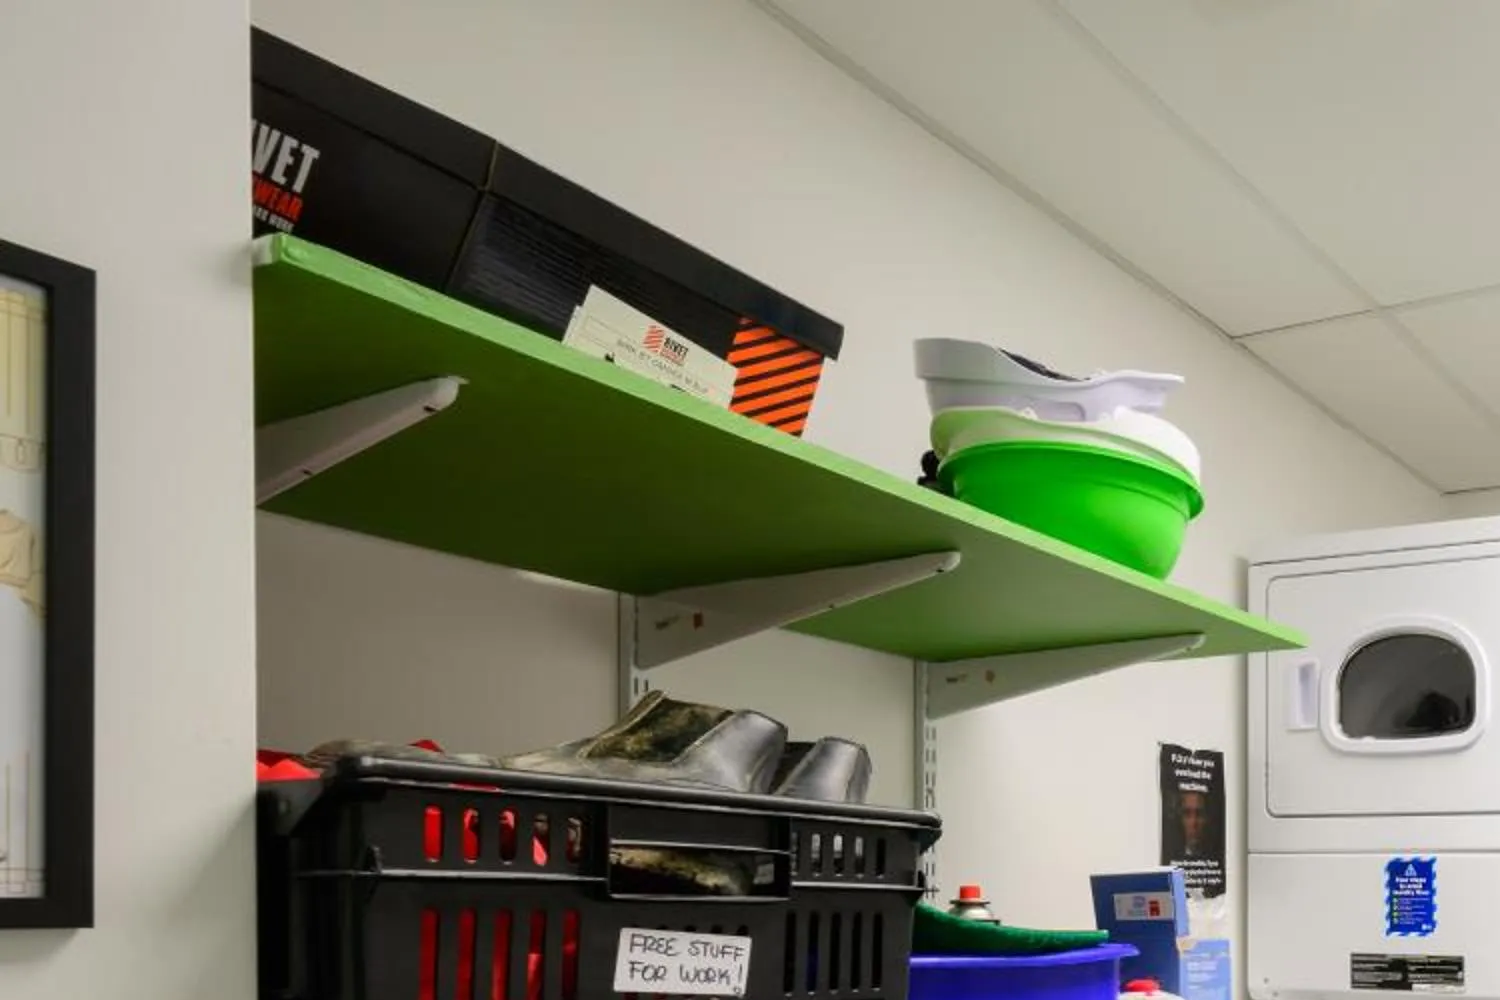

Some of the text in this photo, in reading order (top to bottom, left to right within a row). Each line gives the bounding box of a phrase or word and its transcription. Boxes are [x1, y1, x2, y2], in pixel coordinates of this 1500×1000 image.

[629, 933, 745, 962] FREE STUFF
[628, 960, 667, 983] FOR
